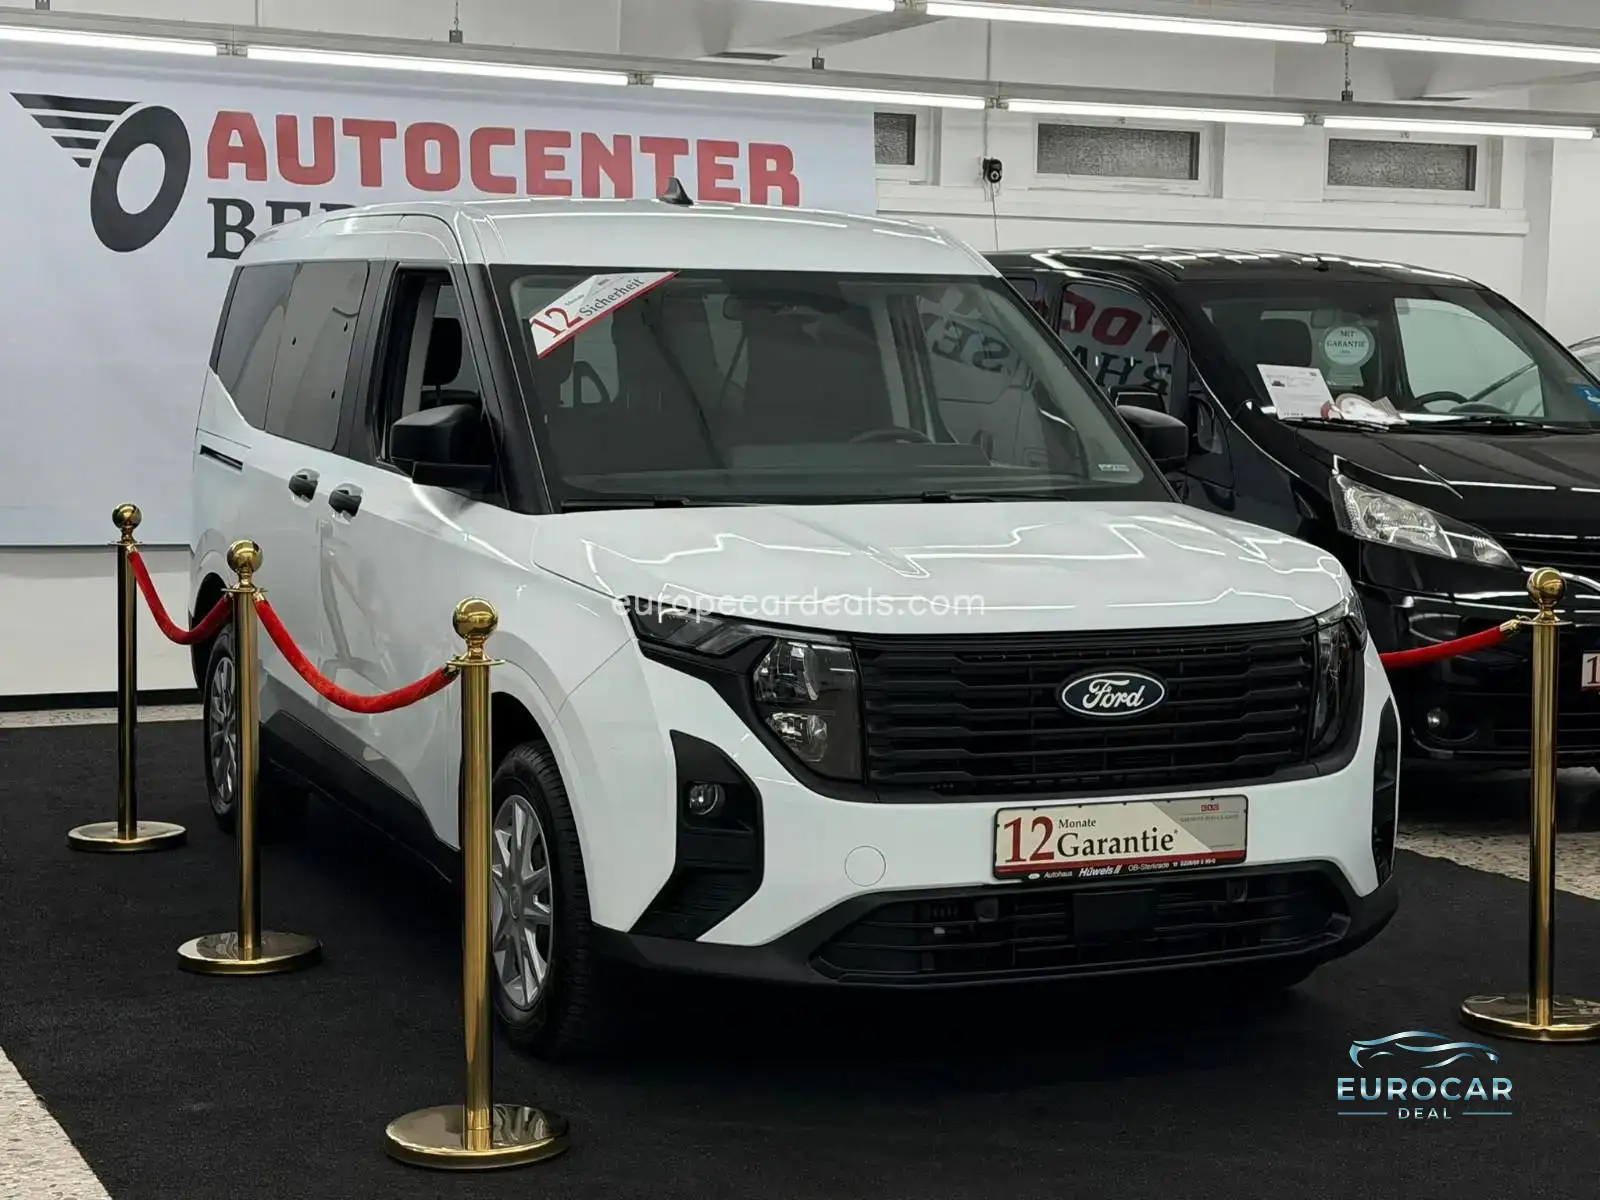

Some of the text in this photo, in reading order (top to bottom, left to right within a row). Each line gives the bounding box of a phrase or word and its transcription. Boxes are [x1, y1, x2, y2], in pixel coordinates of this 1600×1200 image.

[207, 110, 800, 206] AUTOCENTER
[532, 277, 646, 338] 12 Sicherheit
[1082, 679, 1146, 709] Ford
[1003, 816, 1055, 863] 12
[1058, 818, 1096, 829] Monate
[1044, 871, 1073, 879] Autohaus
